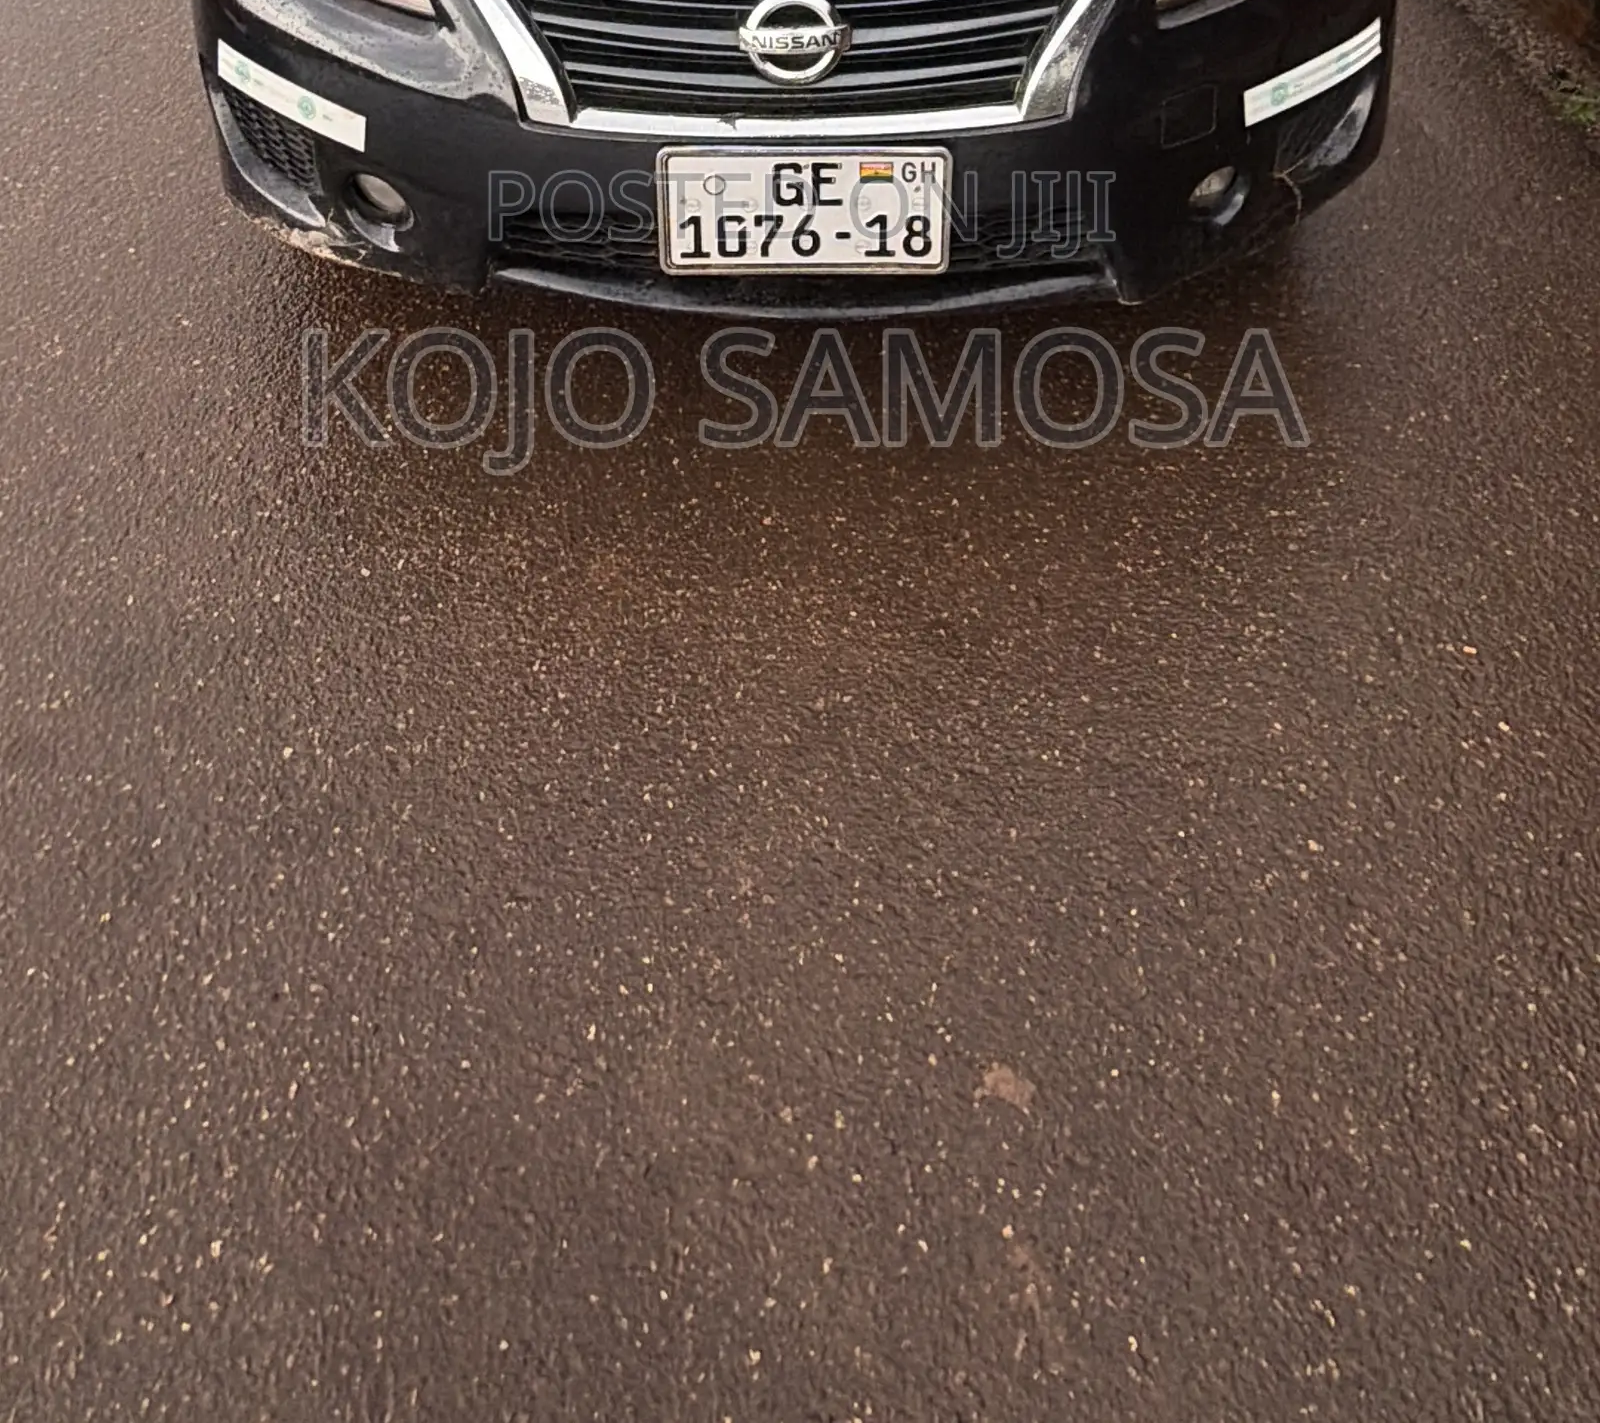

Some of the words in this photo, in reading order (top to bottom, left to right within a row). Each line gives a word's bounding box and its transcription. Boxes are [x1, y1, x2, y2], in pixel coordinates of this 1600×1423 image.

[751, 33, 839, 50] NISSAN
[773, 162, 844, 207] GE
[901, 161, 937, 183] GH
[679, 214, 933, 259] 1076-18
